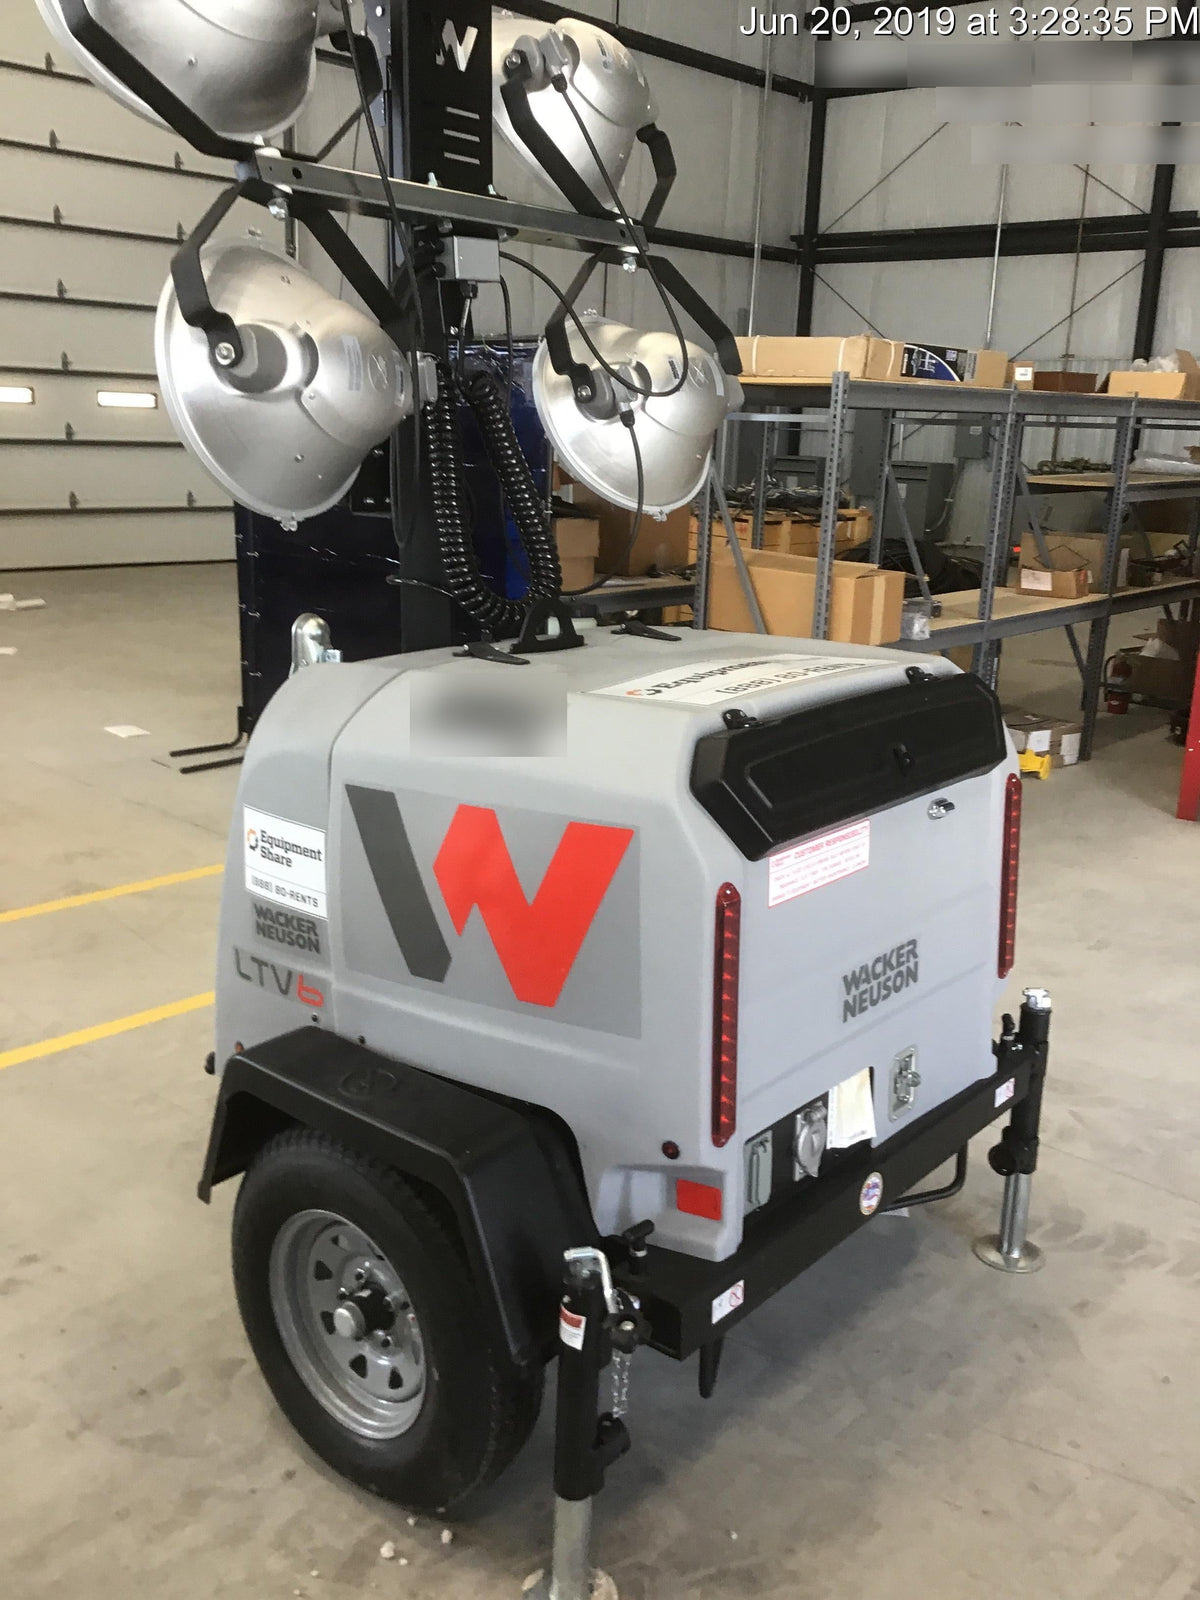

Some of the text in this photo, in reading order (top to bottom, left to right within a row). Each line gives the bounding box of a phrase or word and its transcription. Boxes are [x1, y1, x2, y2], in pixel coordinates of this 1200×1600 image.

[651, 661, 773, 689] Equipmen
[260, 829, 323, 862] Equipment
[260, 845, 293, 868] Share
[275, 884, 319, 908] 80-RENTS
[253, 903, 319, 936] WACKER
[256, 921, 321, 954] NEUSON
[842, 938, 919, 996] WACKER
[842, 960, 919, 1024] NEUSON
